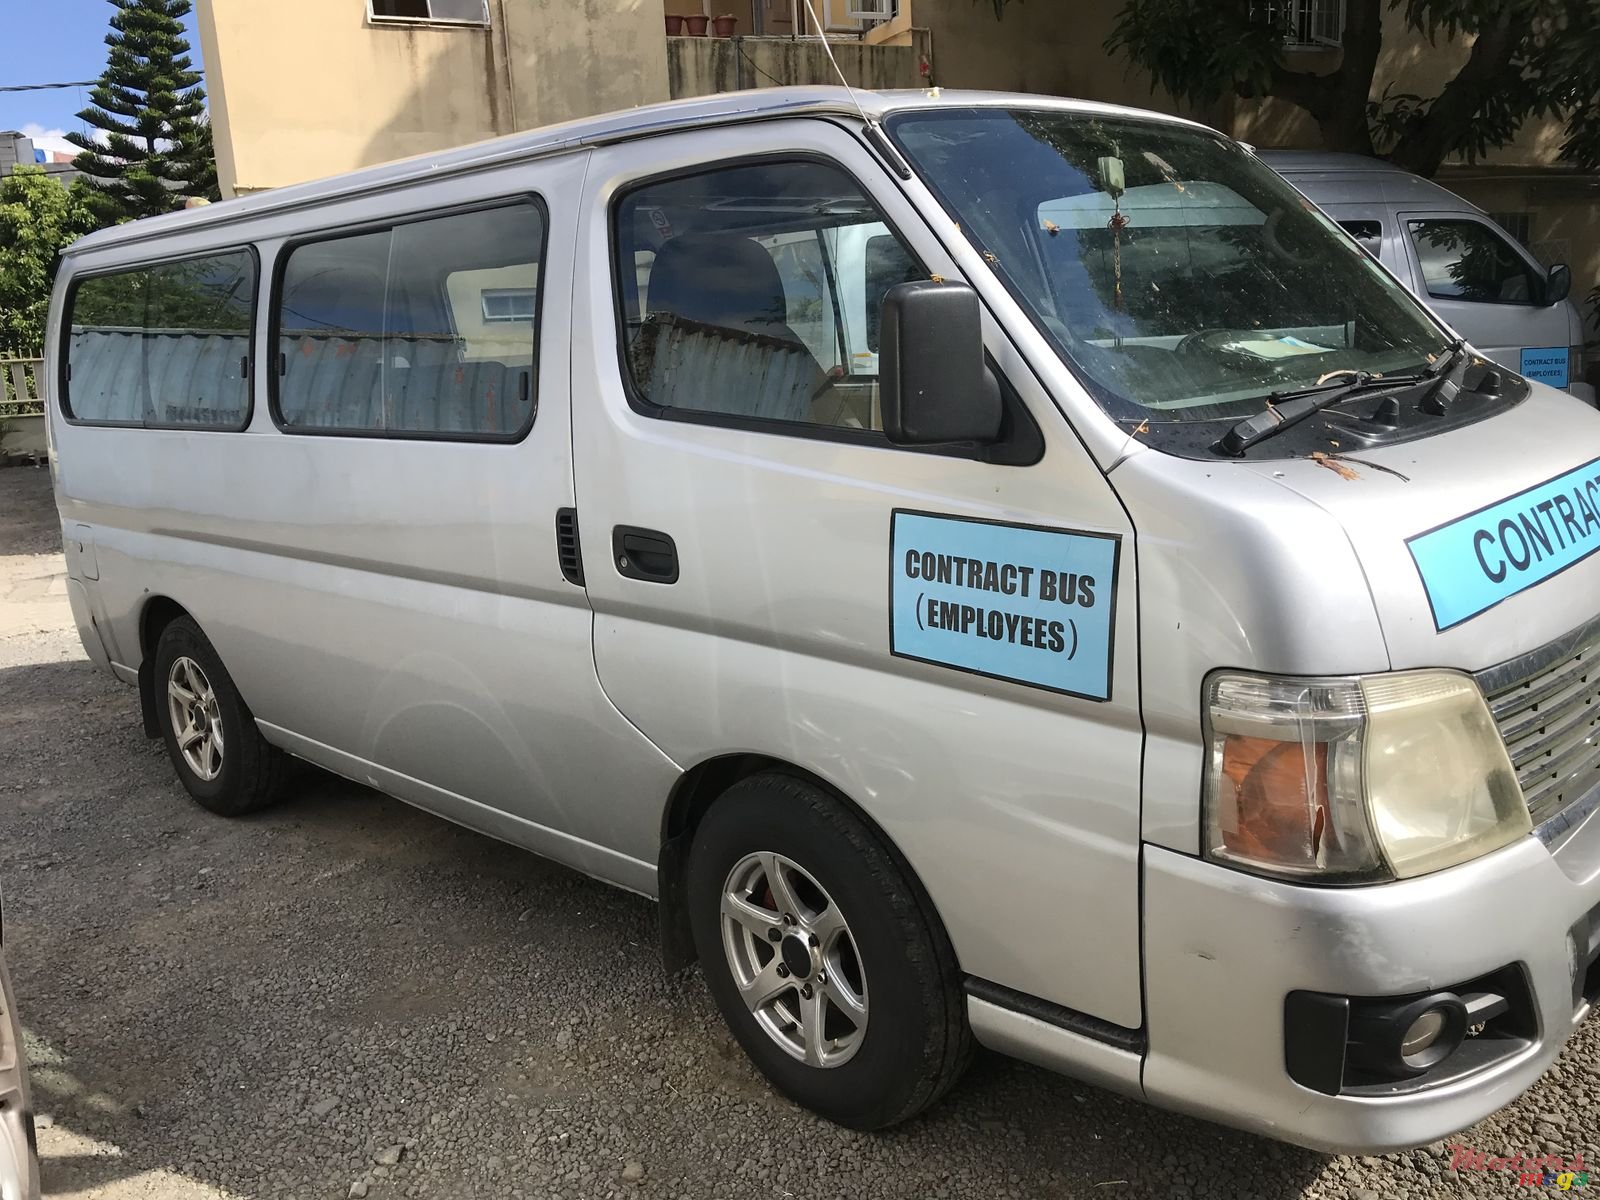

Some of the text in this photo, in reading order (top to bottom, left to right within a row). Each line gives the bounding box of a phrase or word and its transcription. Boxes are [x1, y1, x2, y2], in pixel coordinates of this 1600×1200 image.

[1524, 357, 1566, 366] CONTRACT BUS
[1473, 475, 1600, 584] CONTRAC
[905, 549, 1096, 608] CONTRACT BUS
[916, 593, 1078, 660] (EMPLOYEES)
